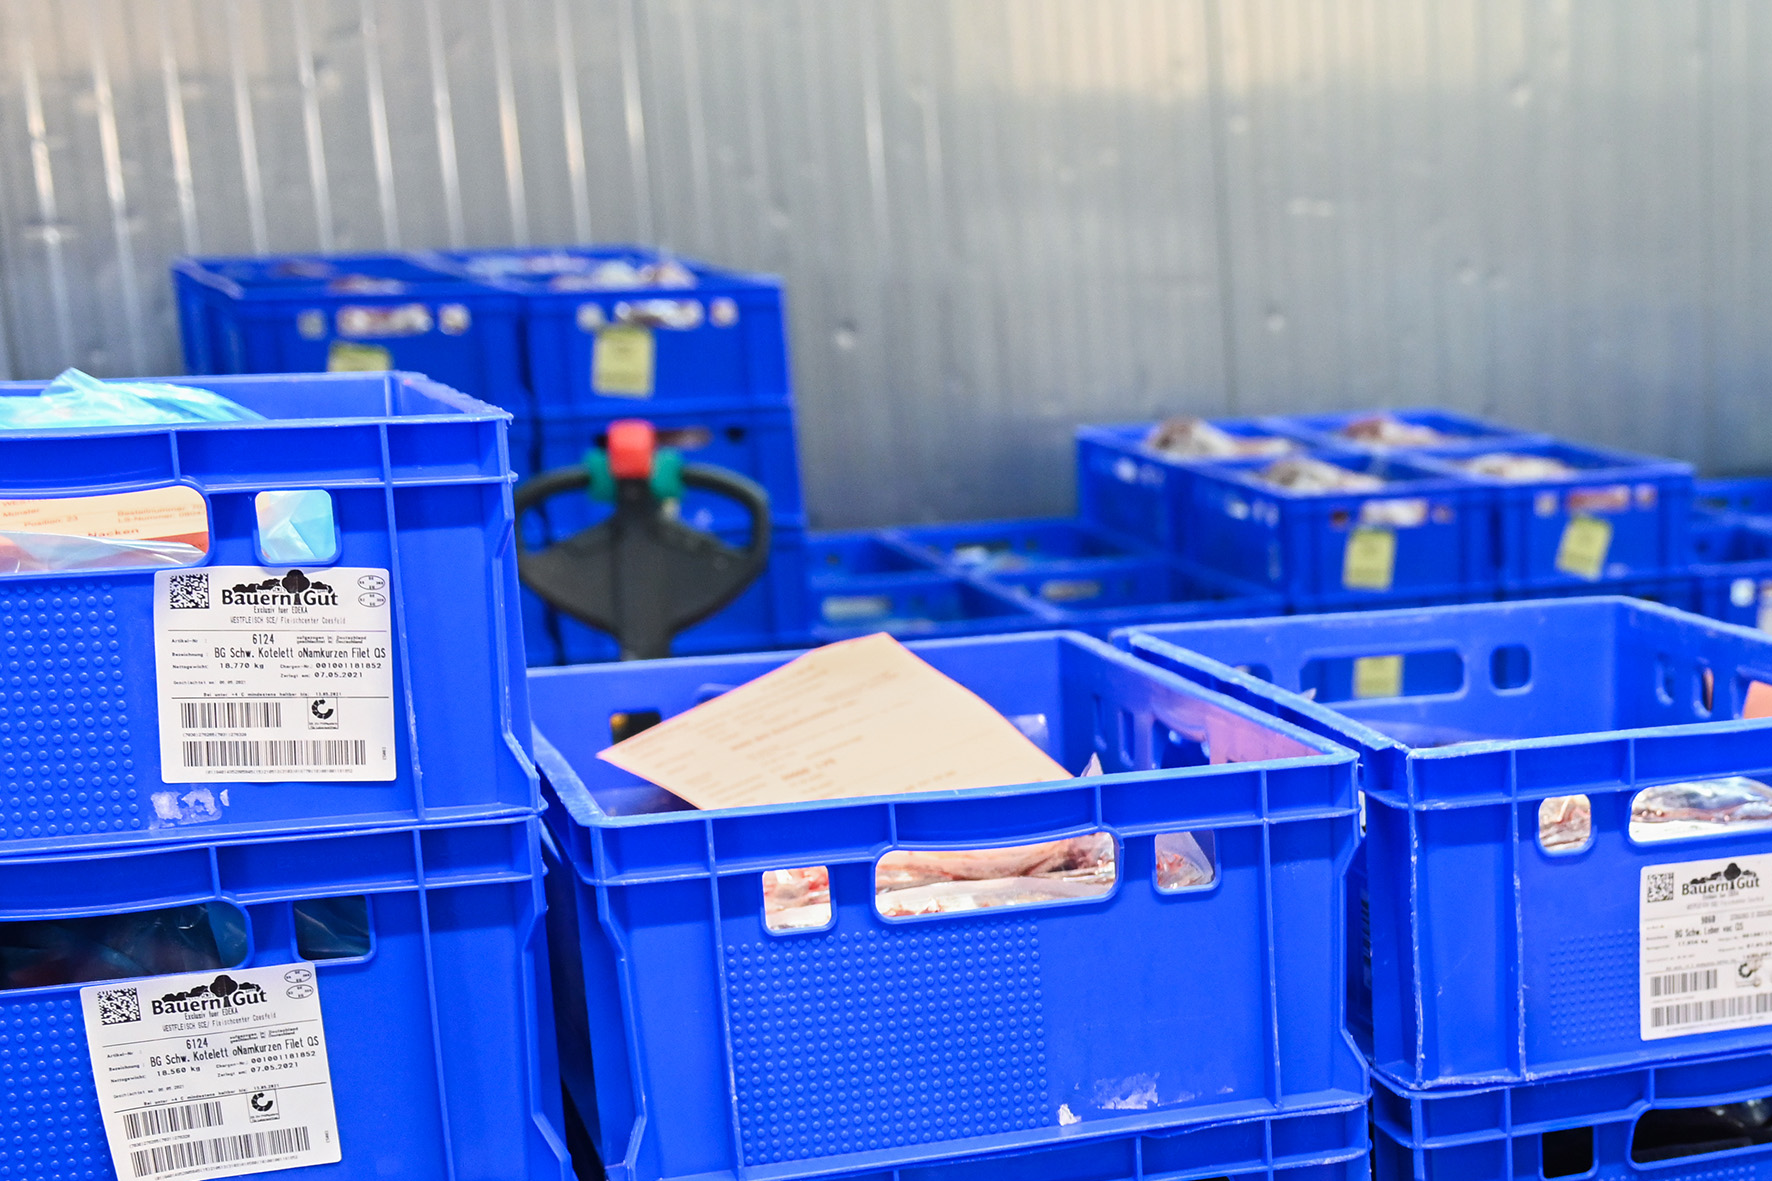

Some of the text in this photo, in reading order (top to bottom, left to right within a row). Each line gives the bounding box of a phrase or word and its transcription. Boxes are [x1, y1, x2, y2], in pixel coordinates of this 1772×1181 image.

[222, 590, 338, 606] Bauern Gut
[254, 606, 274, 614] Exclusiv
[252, 634, 274, 644] 6124
[214, 648, 226, 658] BG
[230, 648, 254, 658] Schw.
[258, 648, 294, 658] Kotelett
[352, 648, 370, 658] Filet
[374, 648, 386, 658] QS
[1682, 877, 1759, 895] Bauern Gut
[151, 991, 267, 1015] Bauern Gut
[185, 1012, 206, 1021] Exclusiv
[222, 1008, 238, 1016] EDEKA
[163, 1023, 196, 1032] WESTFLEISCH
[212, 1016, 250, 1027] Fleischcenter
[252, 1012, 276, 1022] Coesfeld
[186, 1038, 208, 1050] 6124
[150, 1056, 161, 1067] BG
[166, 1054, 190, 1065] Schw.
[194, 1048, 228, 1062] Kotelett
[285, 1039, 304, 1050] Filet
[307, 1036, 319, 1048] QS
[251, 1051, 316, 1064] 001001181852
[157, 1067, 186, 1077] 18.560
[250, 1062, 298, 1073] 07.05.2021
